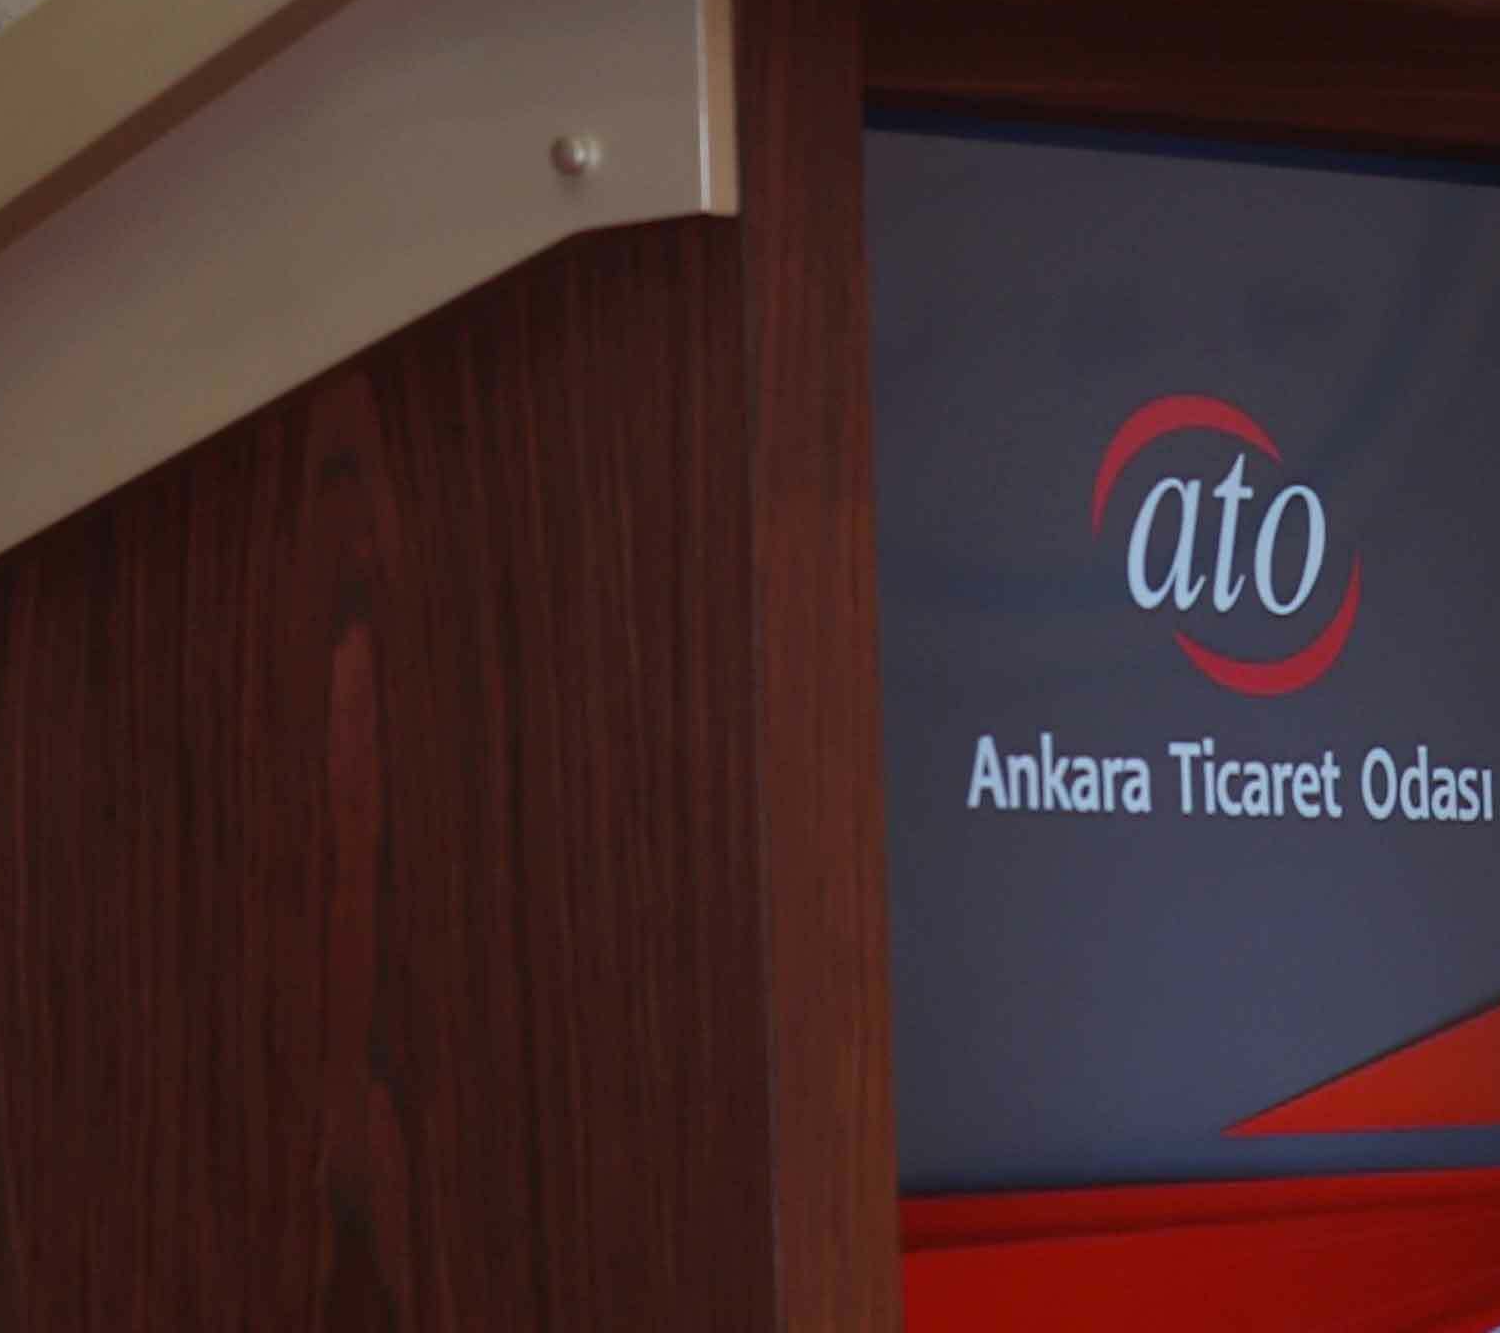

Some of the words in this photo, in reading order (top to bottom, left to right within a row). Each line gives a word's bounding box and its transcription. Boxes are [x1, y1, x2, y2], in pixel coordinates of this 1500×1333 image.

[1125, 451, 1328, 617] ato
[965, 730, 1154, 816] Ankara
[1166, 735, 1345, 820] Ticaret
[1359, 743, 1495, 824] Odası
